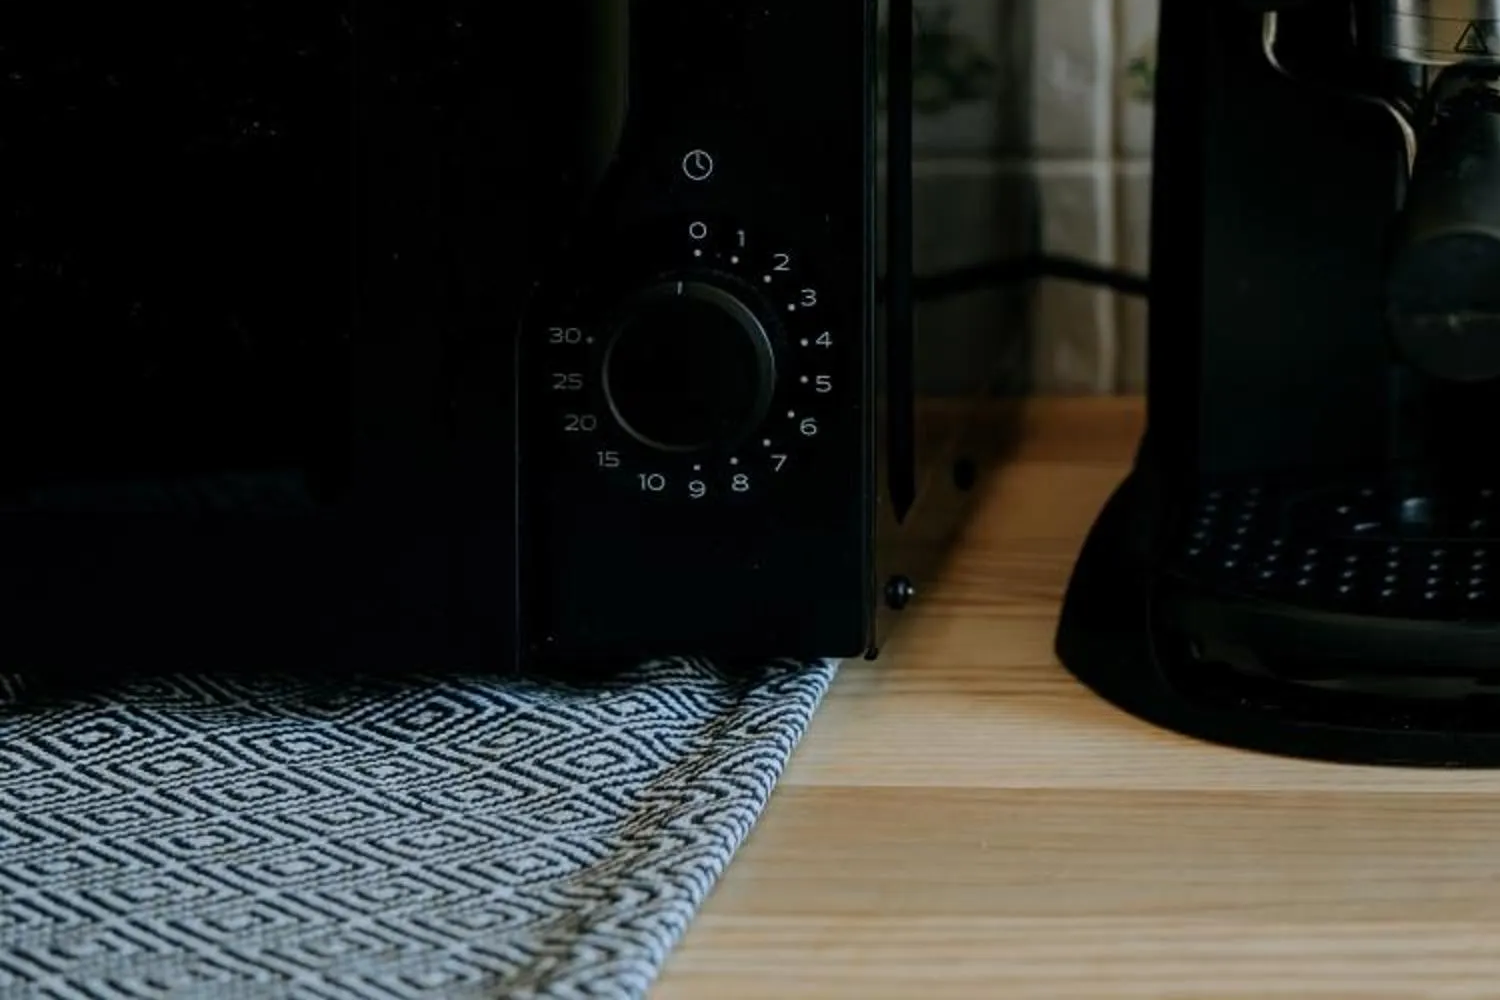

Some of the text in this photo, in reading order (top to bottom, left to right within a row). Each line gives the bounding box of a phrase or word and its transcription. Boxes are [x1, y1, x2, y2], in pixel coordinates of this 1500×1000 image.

[736, 230, 745, 247] 1
[773, 253, 790, 271] 2
[801, 288, 817, 307] 3
[549, 327, 582, 343] 30
[815, 331, 833, 348] 4
[552, 373, 583, 390] 25
[815, 375, 832, 393] 5
[564, 414, 597, 431] 20
[800, 417, 817, 436] 6
[597, 451, 620, 468] 15
[771, 454, 787, 472] 7
[638, 473, 666, 491] 10
[688, 480, 706, 499] 9
[731, 473, 749, 492] 8
